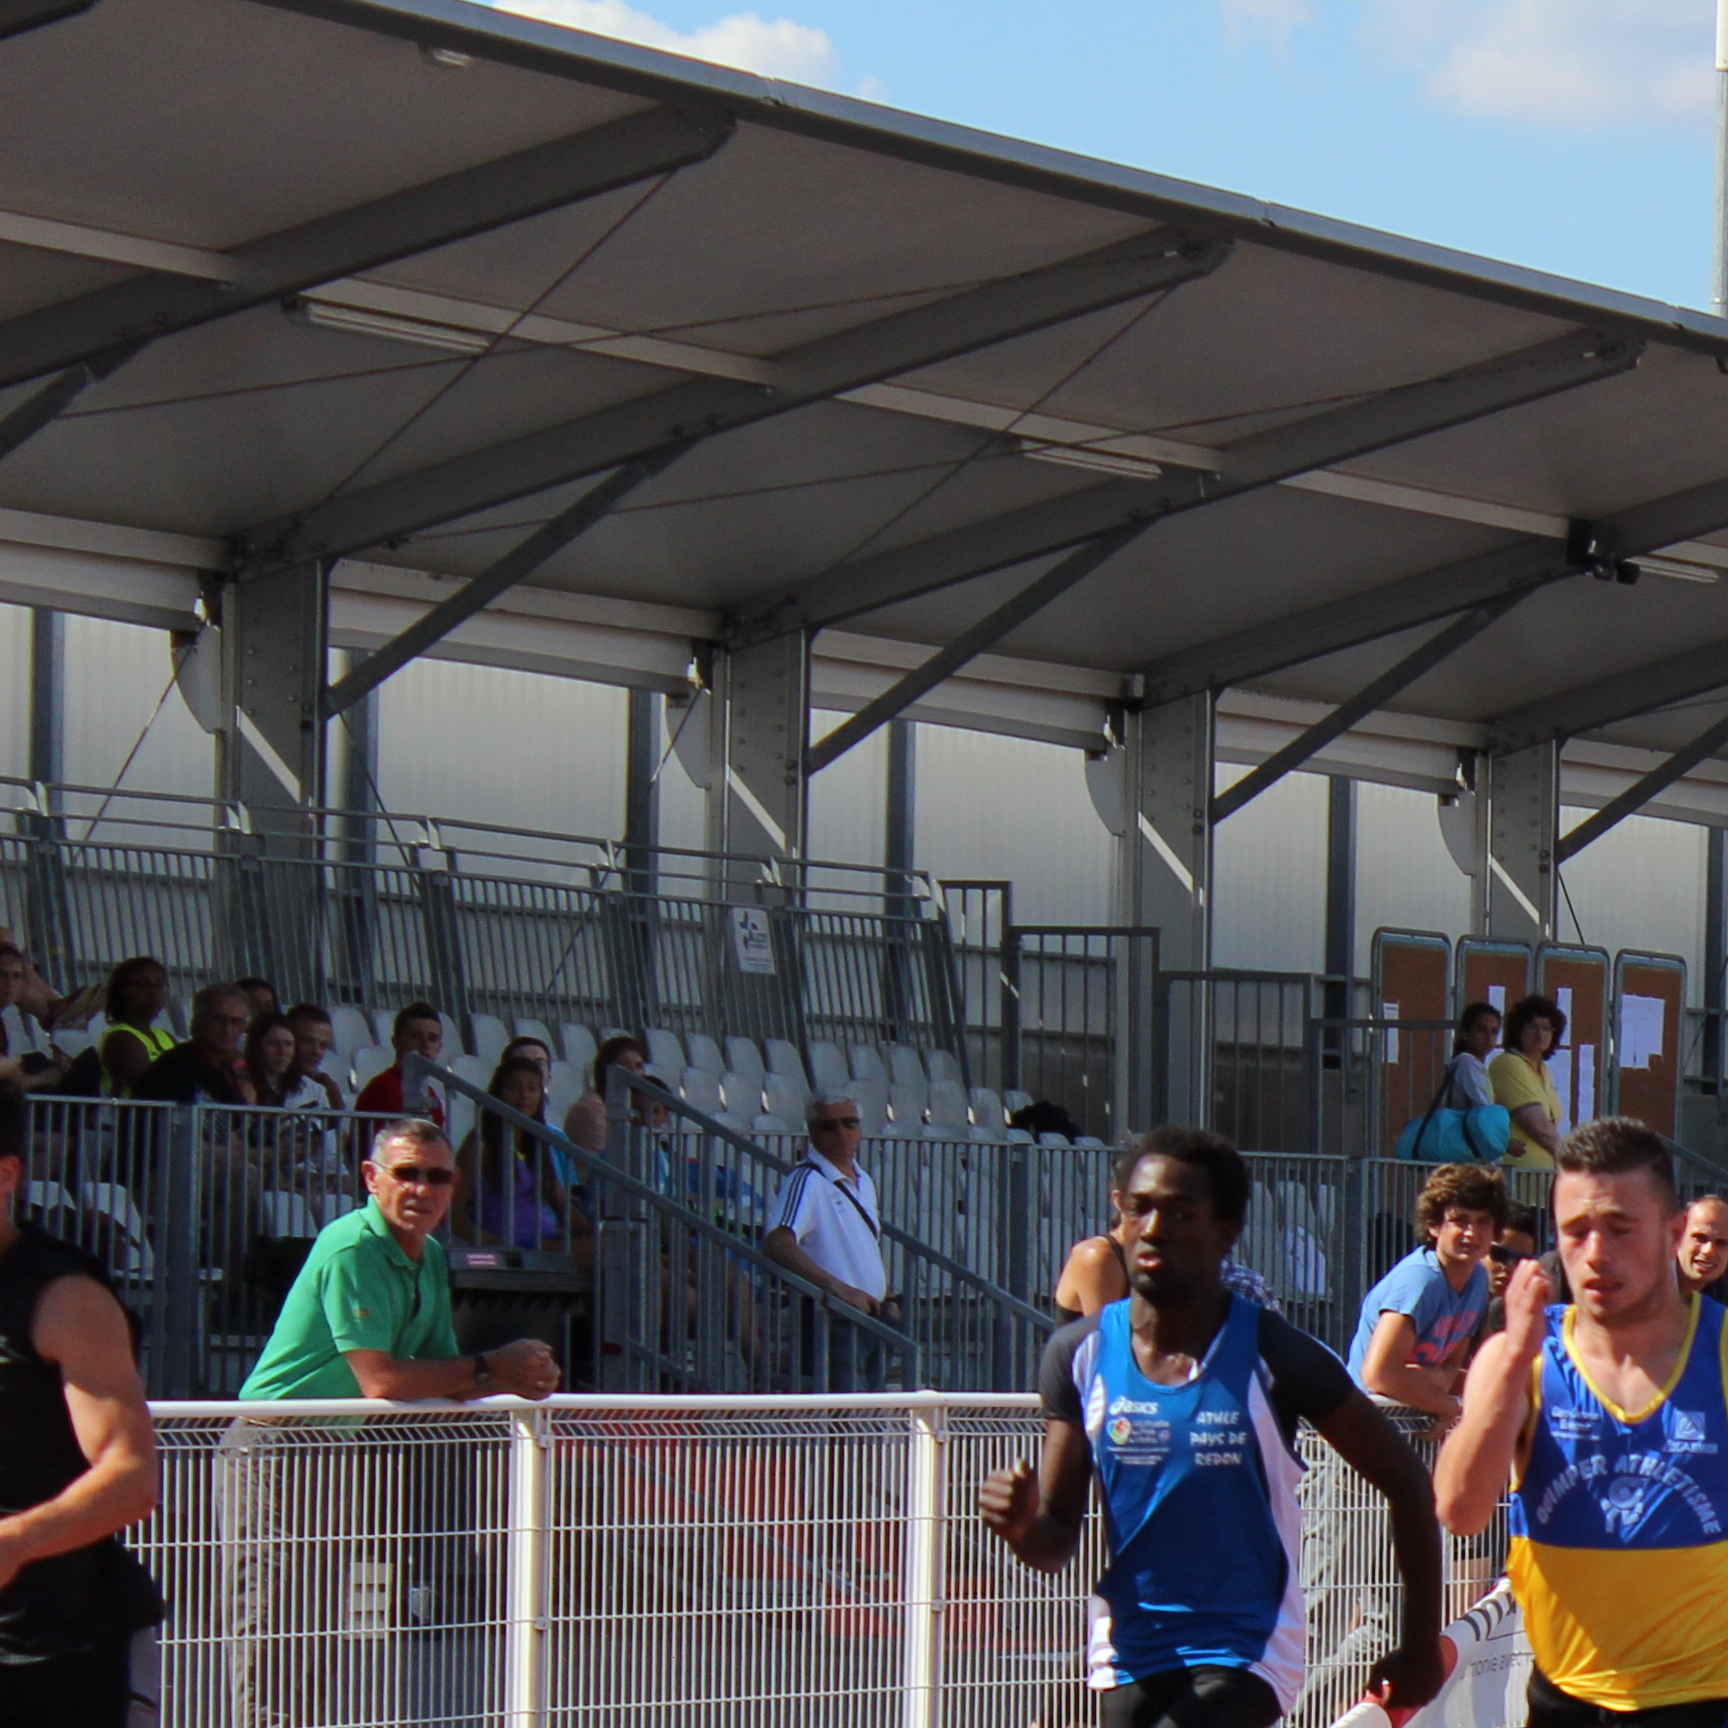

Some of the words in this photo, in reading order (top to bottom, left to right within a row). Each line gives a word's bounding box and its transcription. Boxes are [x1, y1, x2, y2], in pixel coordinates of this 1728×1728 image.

[1122, 1399, 1160, 1416] asics
[1189, 1430, 1226, 1447] PAYS
[1228, 1431, 1248, 1446] DE
[1193, 1451, 1243, 1467] REDON
[1536, 1454, 1607, 1525] QUIMPER
[1614, 1453, 1722, 1535] ATHLETISME
